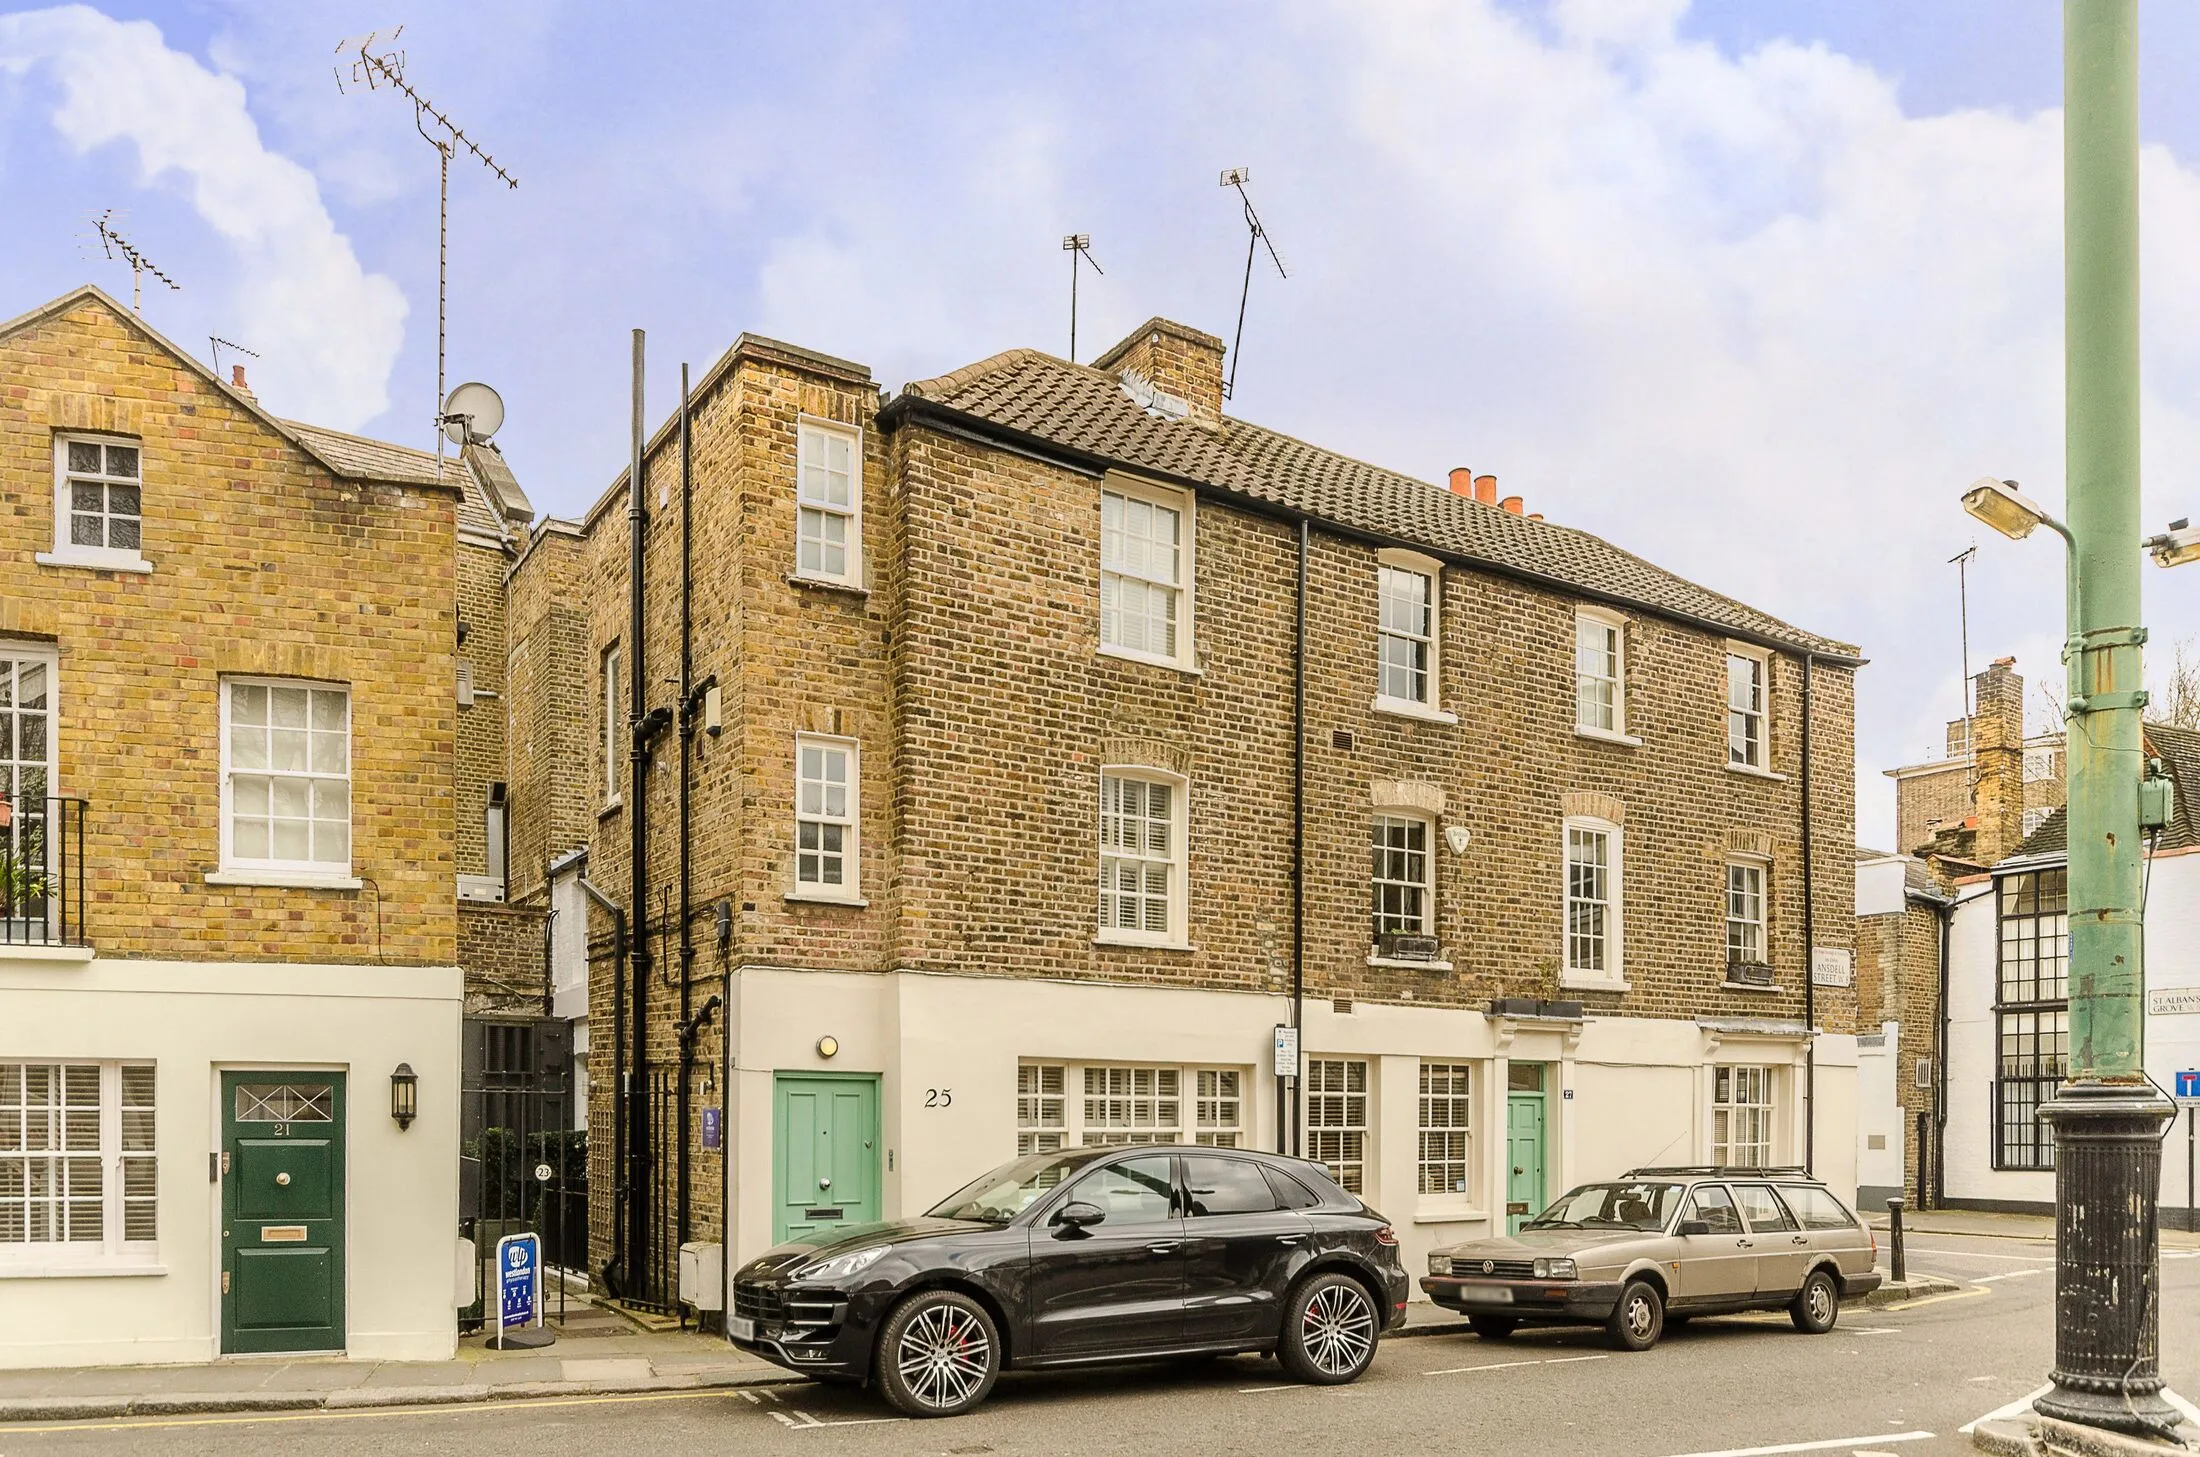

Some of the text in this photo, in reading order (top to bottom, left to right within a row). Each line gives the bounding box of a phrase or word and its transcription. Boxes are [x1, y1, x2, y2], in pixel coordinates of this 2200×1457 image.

[1816, 963, 1846, 974] ANSDELL
[1813, 972, 1837, 983] STREET
[2153, 1004, 2186, 1012] GROVE
[924, 1088, 952, 1108] 25
[274, 1123, 290, 1136] 21
[538, 1167, 550, 1177] 23
